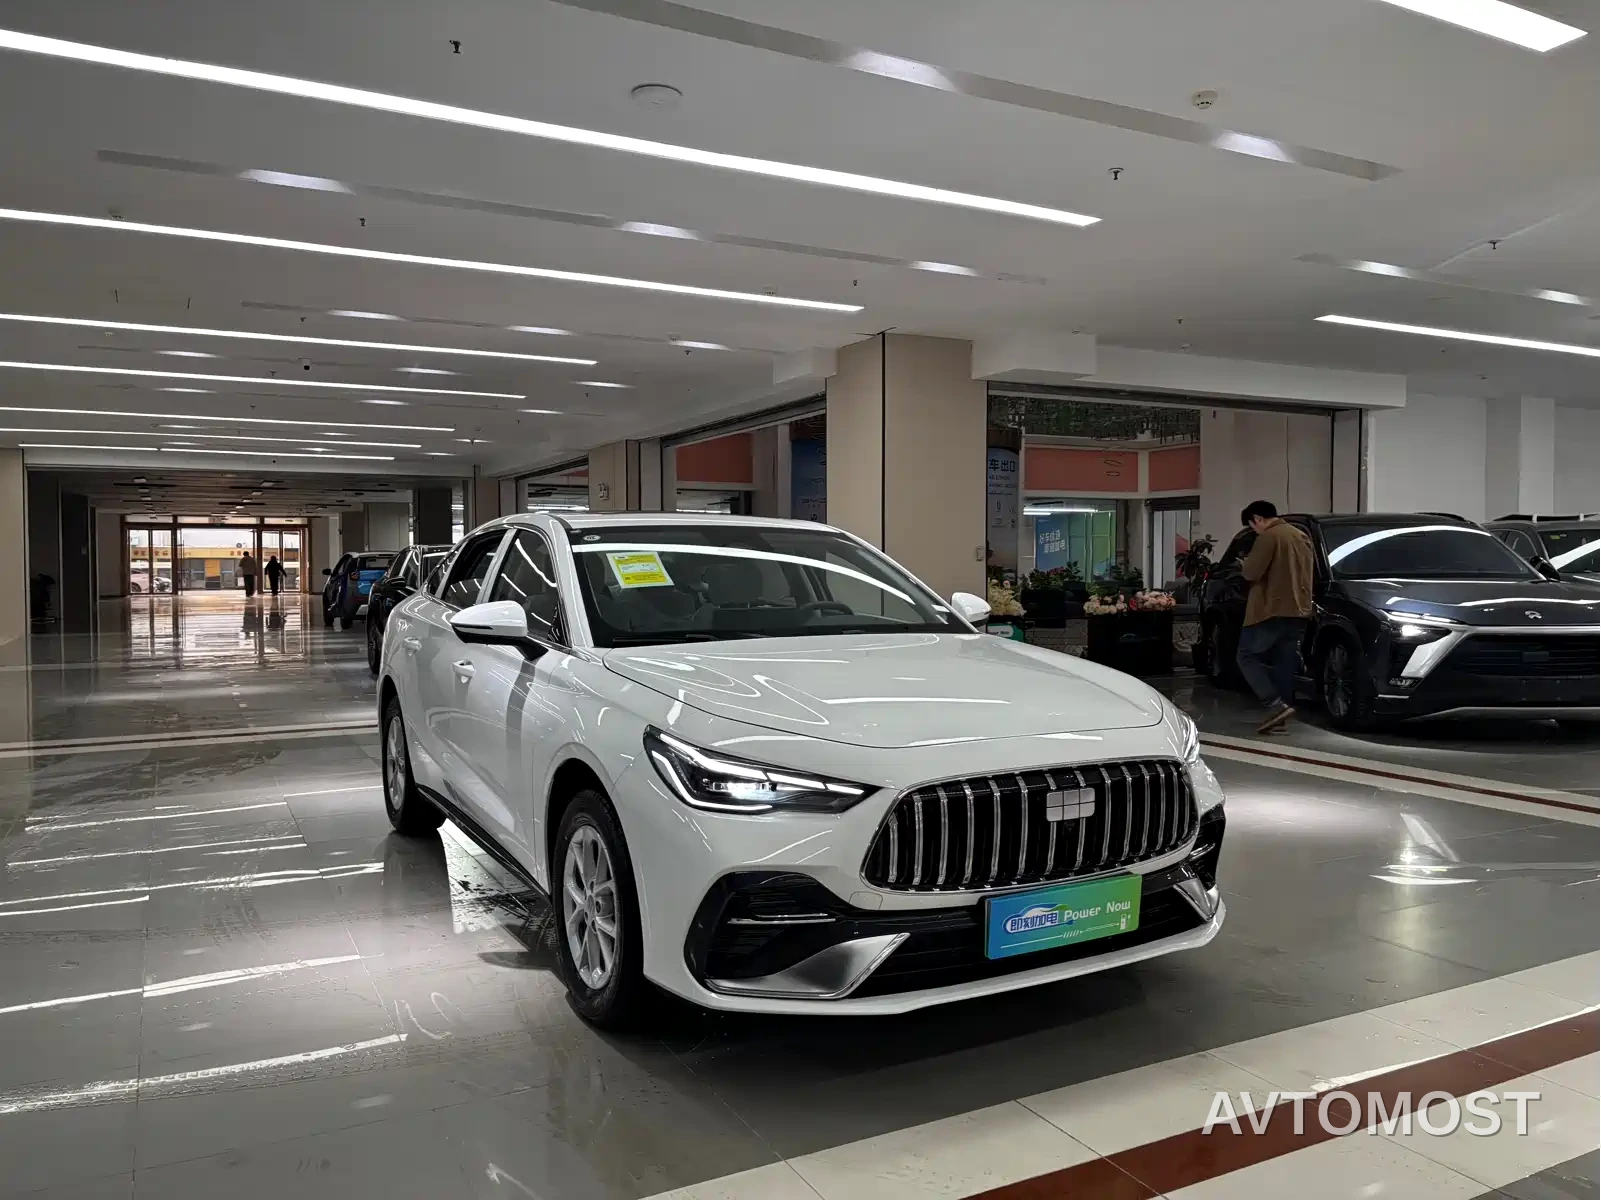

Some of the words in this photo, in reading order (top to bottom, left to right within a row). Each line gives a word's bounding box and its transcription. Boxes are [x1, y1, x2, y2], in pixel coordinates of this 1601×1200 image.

[1064, 906, 1101, 921] Power
[1106, 900, 1131, 914] Now
[1010, 912, 1058, 931] 即刻加电
